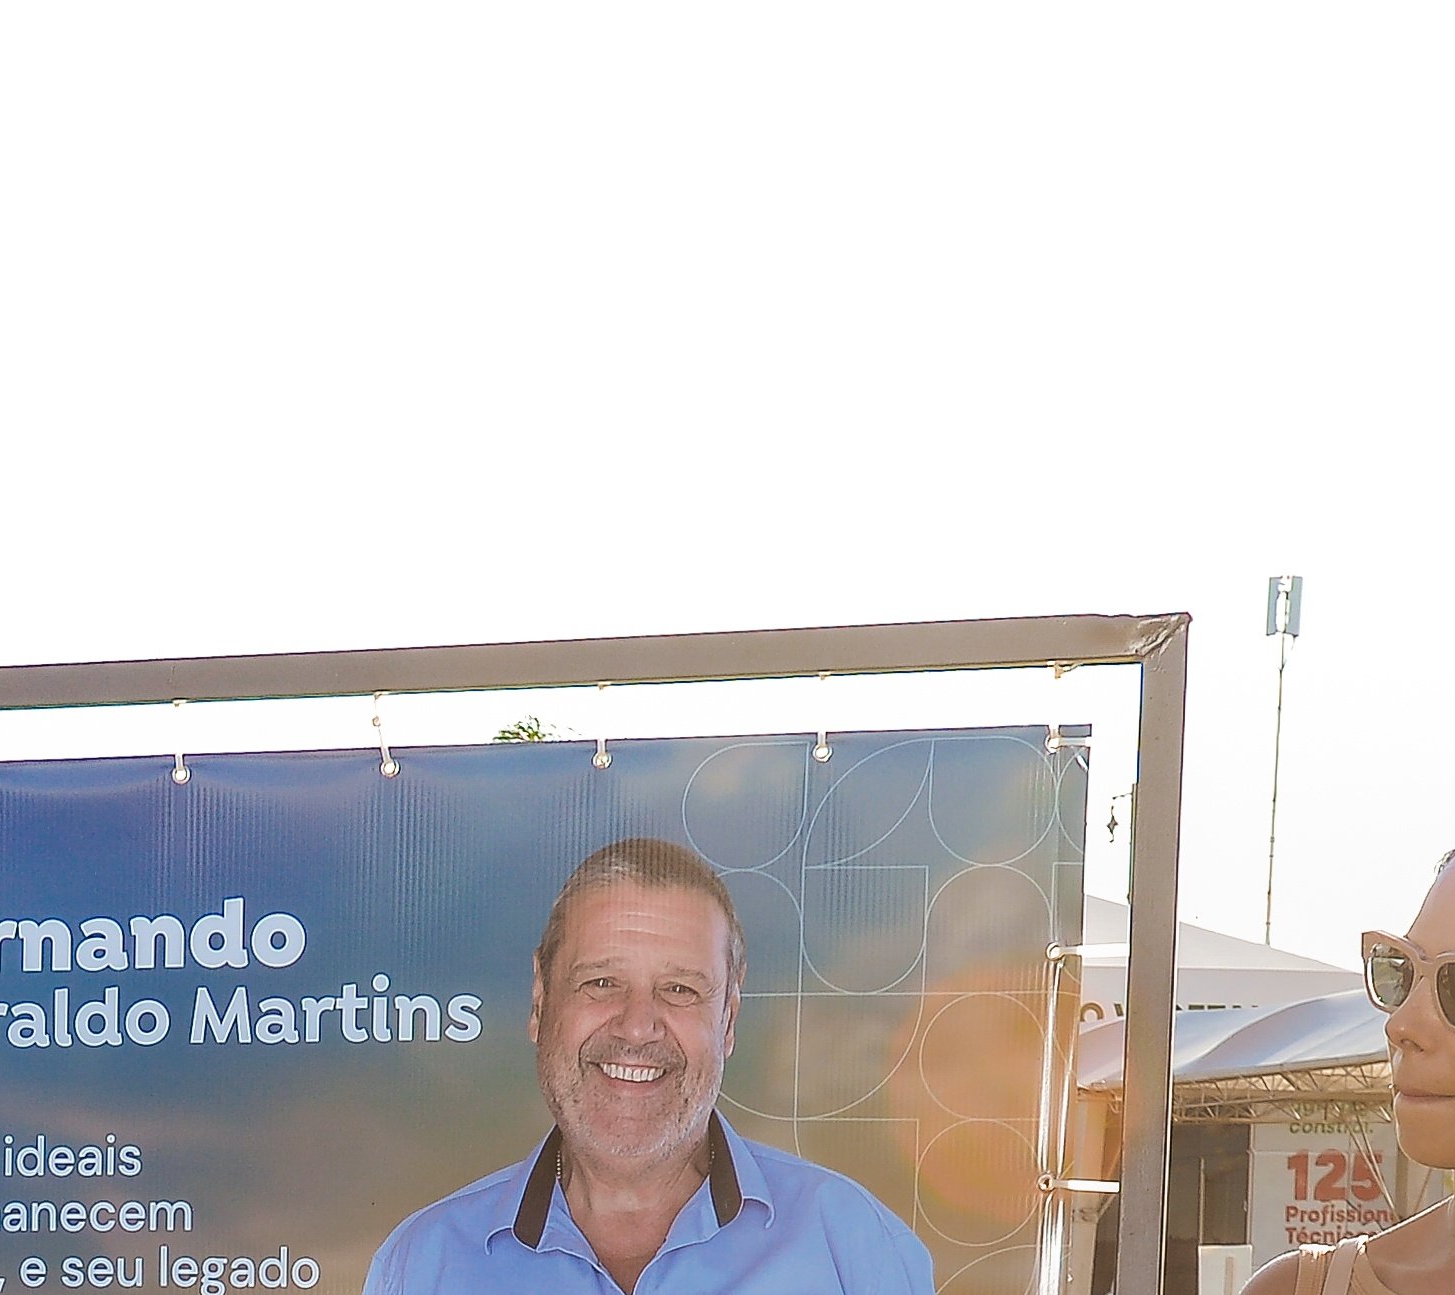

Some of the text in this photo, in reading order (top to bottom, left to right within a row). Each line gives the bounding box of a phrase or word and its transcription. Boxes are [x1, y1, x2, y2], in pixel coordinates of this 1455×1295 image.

[189, 973, 484, 1045] Martins
[3, 1133, 143, 1178] ideais
[1287, 1148, 1384, 1202] 125
[19, 1254, 48, 1289] e
[60, 1254, 144, 1289] seu
